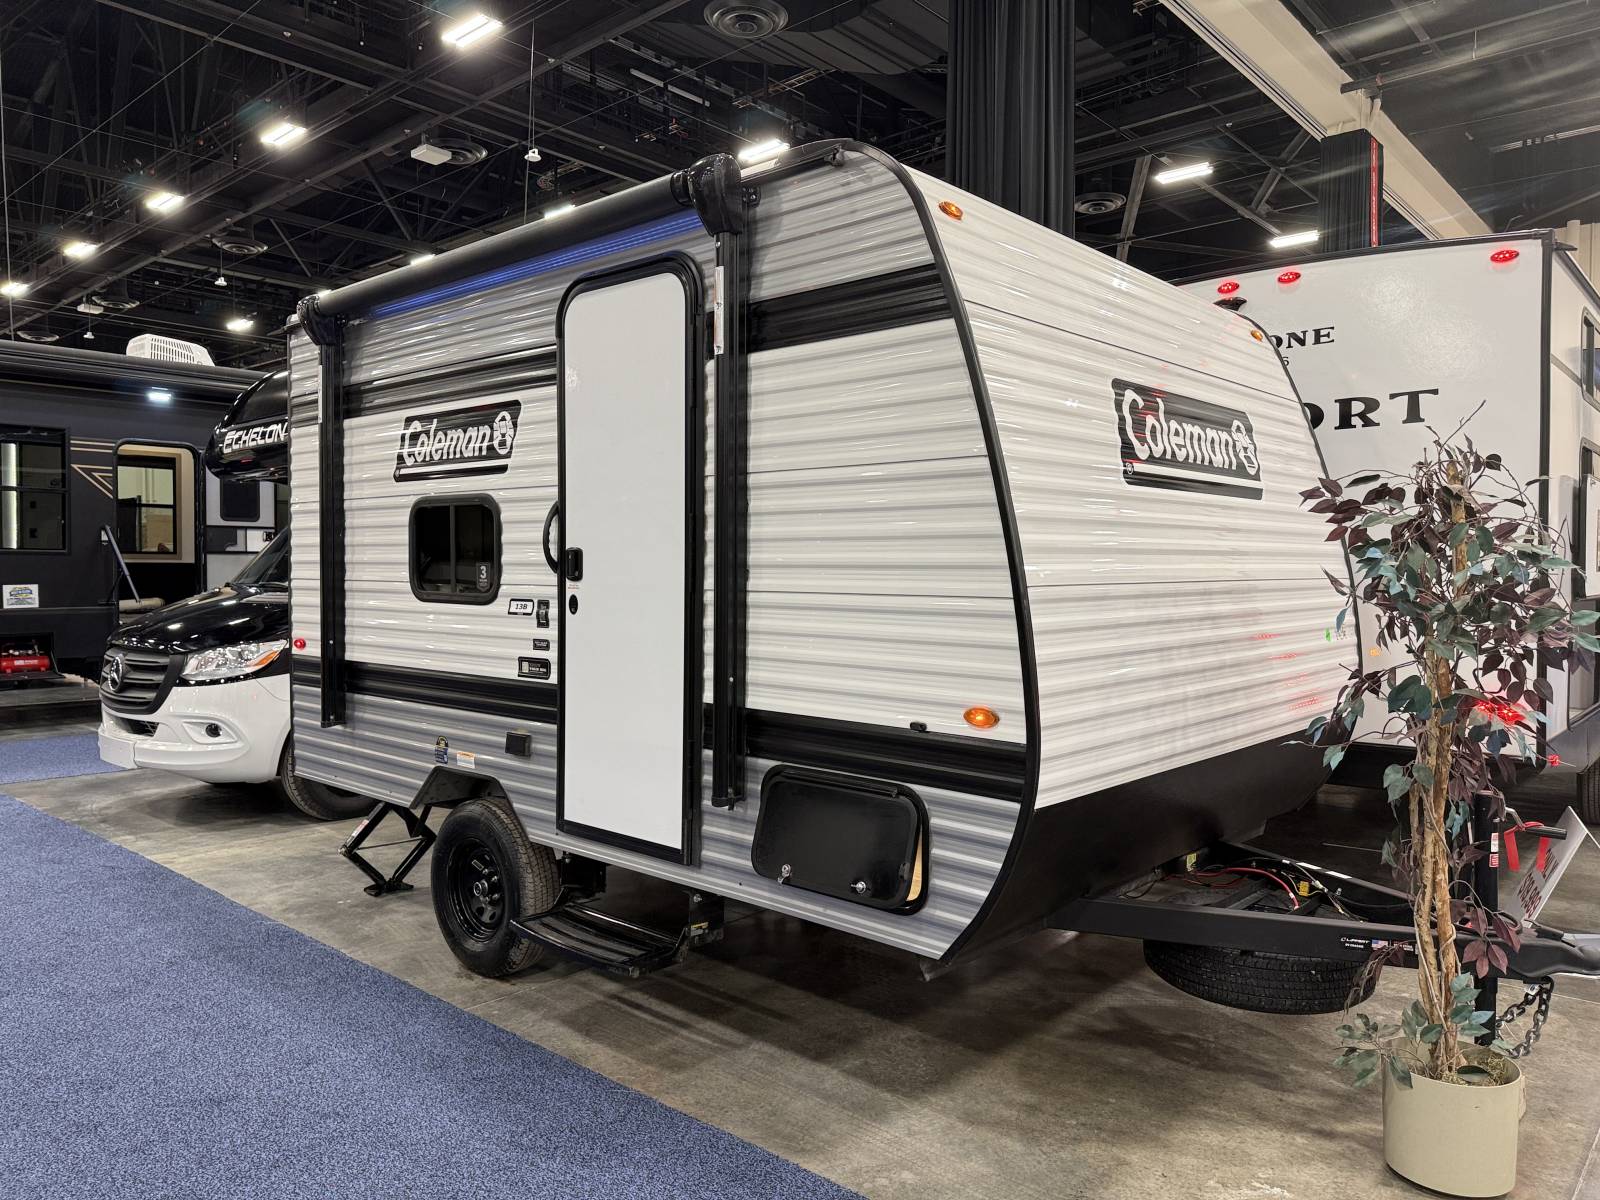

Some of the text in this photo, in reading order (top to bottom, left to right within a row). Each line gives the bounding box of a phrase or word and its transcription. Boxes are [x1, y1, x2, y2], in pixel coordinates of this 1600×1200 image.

[223, 422, 289, 454] ECHELON
[402, 418, 491, 466] Coleman
[1122, 389, 1237, 470] Coleman
[480, 565, 487, 579] 3
